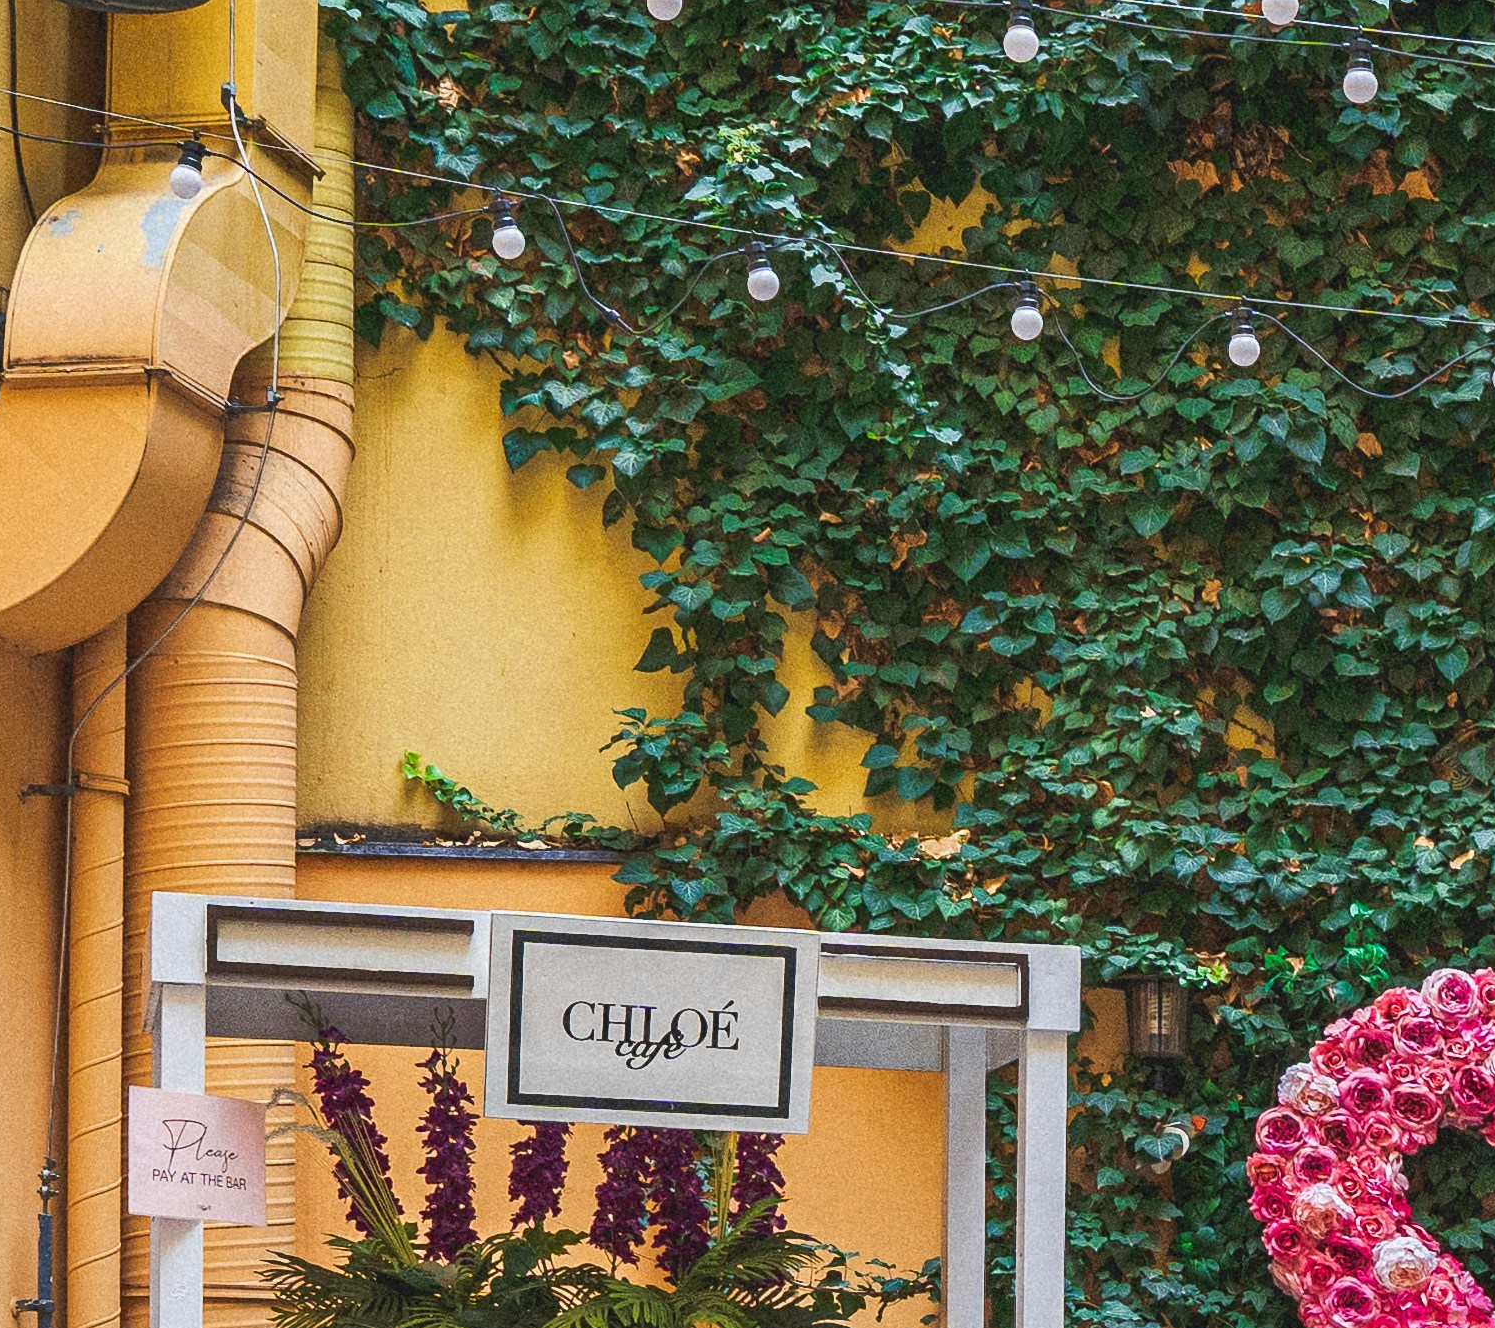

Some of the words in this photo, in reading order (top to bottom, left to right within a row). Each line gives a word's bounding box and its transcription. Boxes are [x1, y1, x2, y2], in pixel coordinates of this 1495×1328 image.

[562, 999, 740, 1051] CHLOÉ
[162, 1119, 239, 1173] Please
[152, 1168, 177, 1183] PAY
[180, 1172, 197, 1185] AT
[200, 1173, 223, 1188] THE
[226, 1176, 247, 1191] BAR
